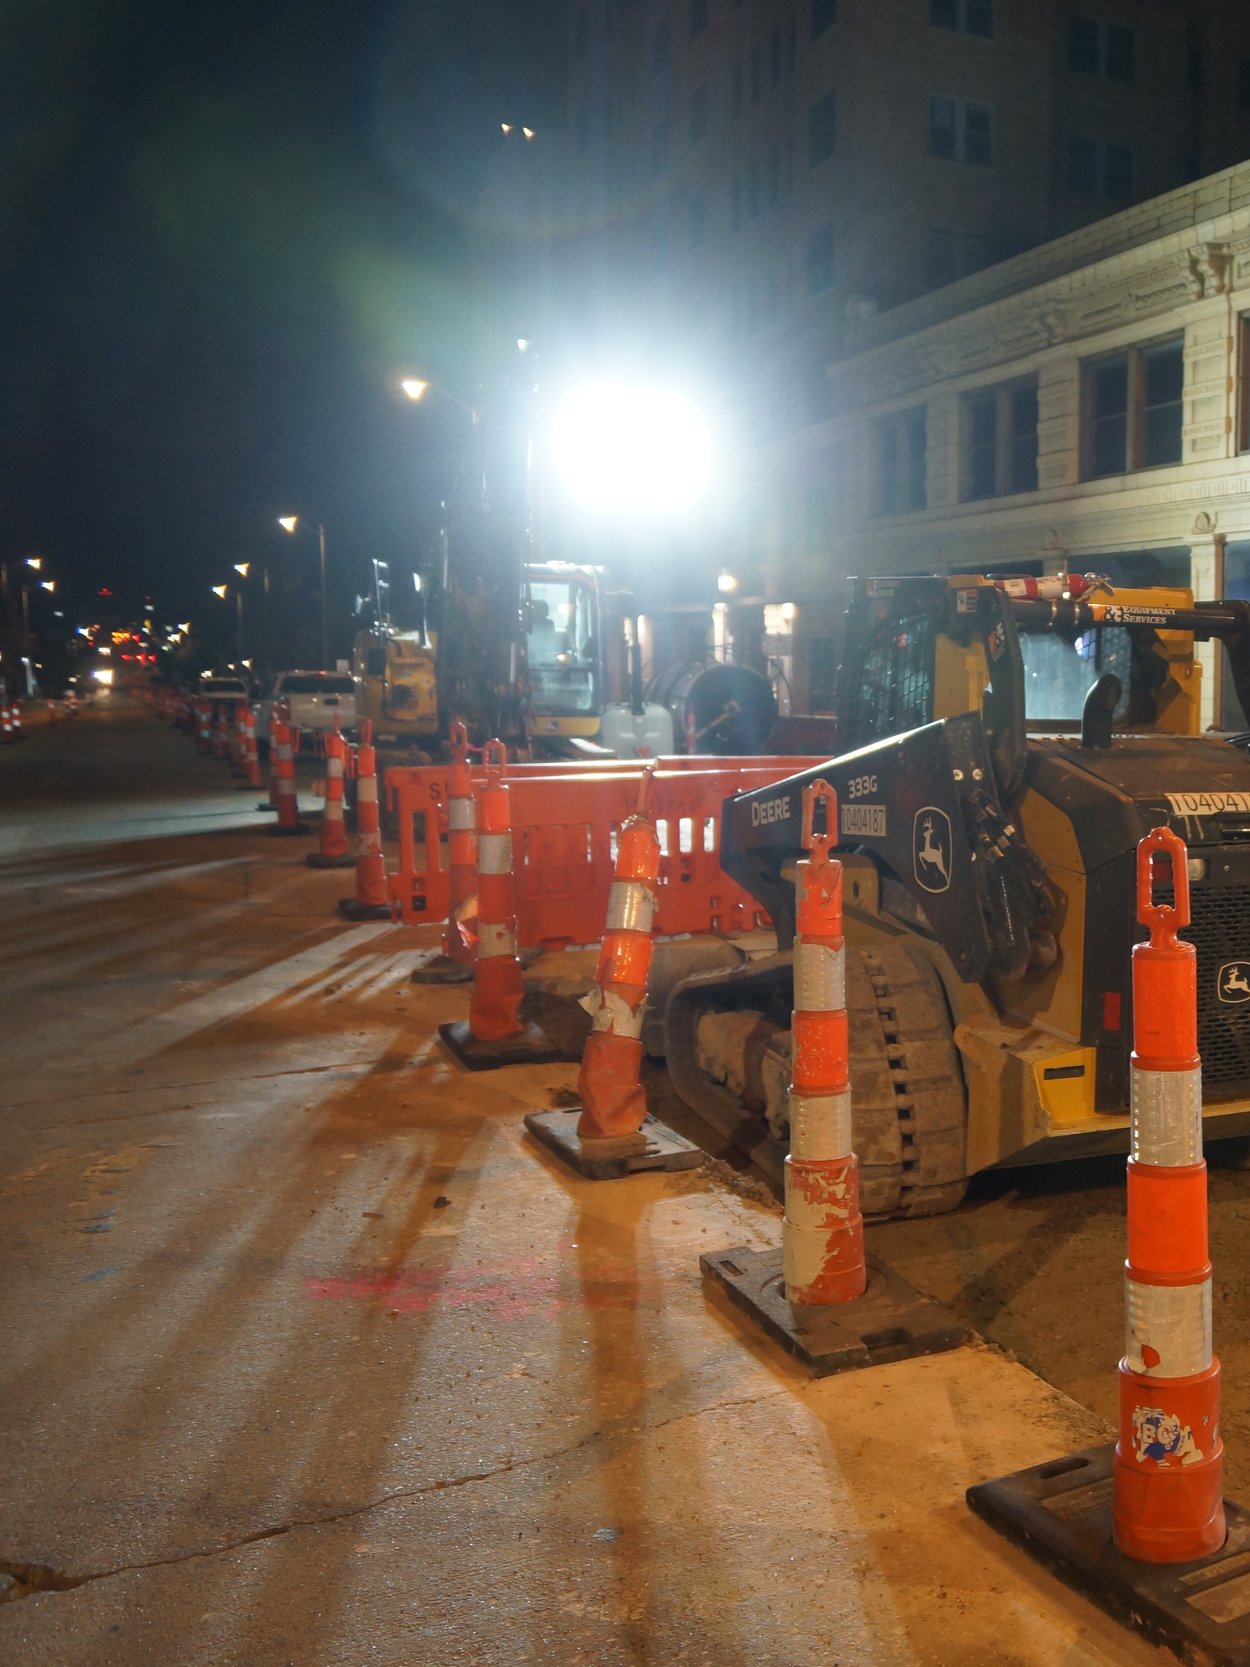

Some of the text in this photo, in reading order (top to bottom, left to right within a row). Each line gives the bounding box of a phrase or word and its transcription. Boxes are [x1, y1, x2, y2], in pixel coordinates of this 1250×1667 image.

[1122, 606, 1176, 615] EQUIPMENT
[1122, 613, 1167, 624] SERVICES
[848, 775, 878, 799] 333G
[752, 796, 791, 827] DEERE
[841, 808, 885, 833] 10404187
